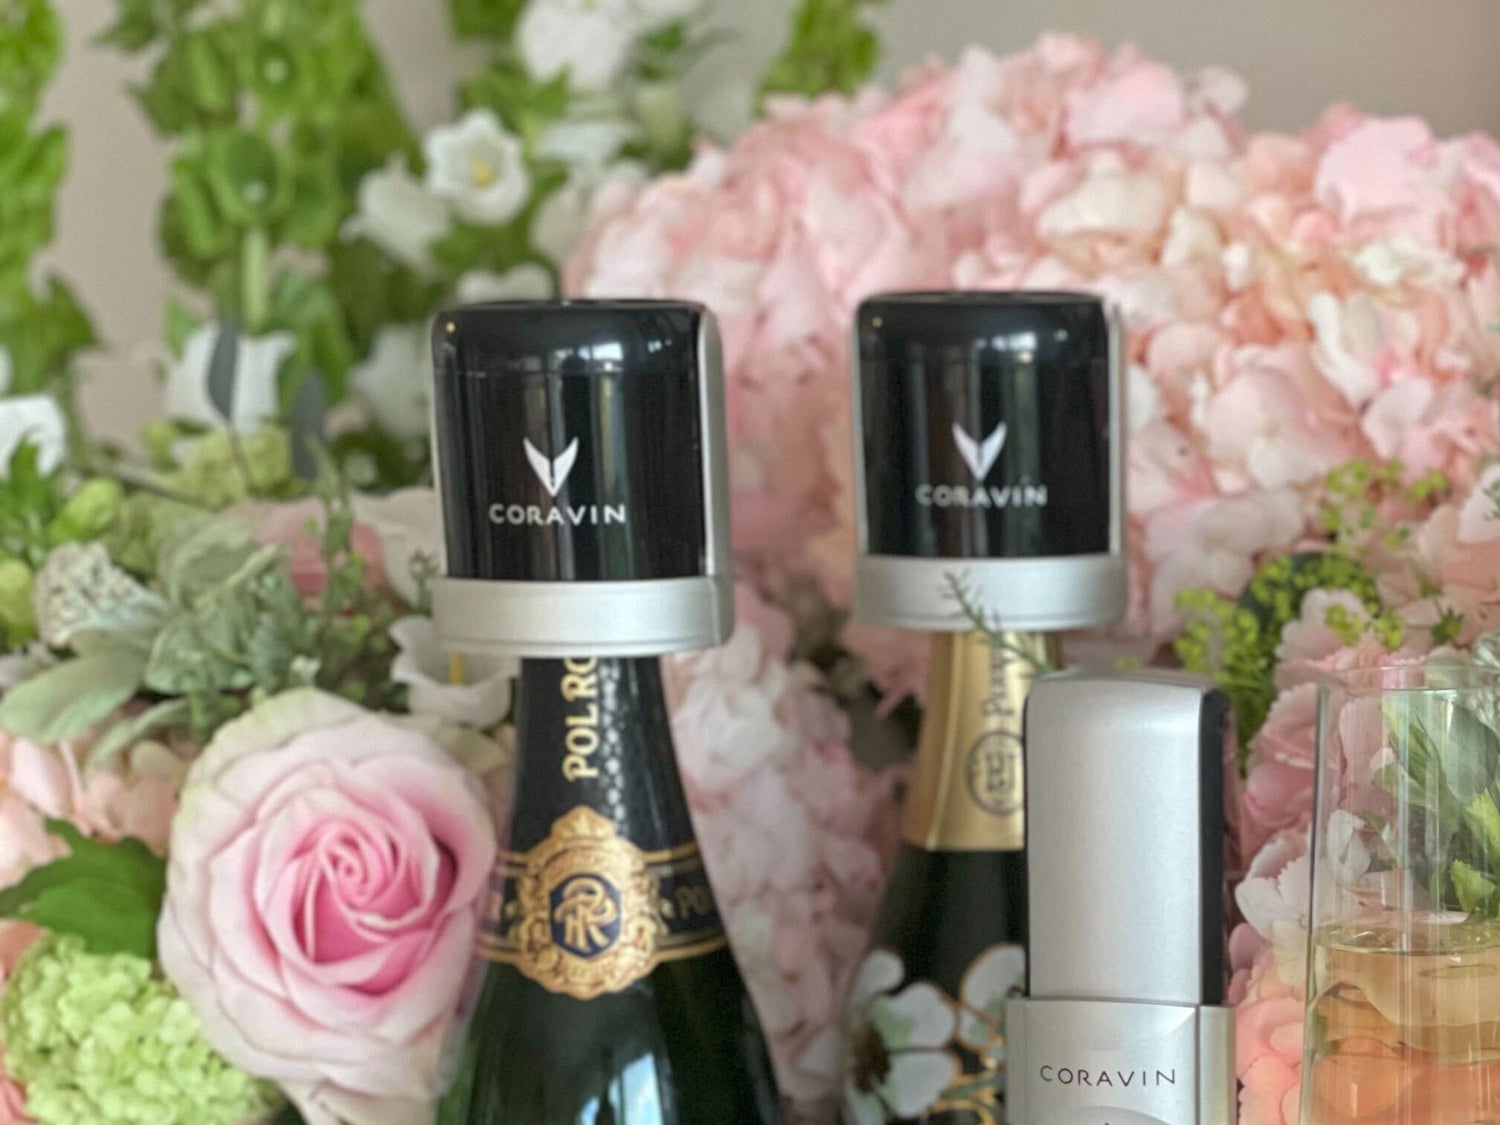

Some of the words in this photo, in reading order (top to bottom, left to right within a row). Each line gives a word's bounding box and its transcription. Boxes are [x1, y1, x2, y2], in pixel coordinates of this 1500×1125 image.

[915, 484, 1048, 508] CORAVIN
[489, 503, 626, 525] CORAVIN
[562, 703, 598, 782] POL
[1040, 1065, 1176, 1087] CORAVIN
